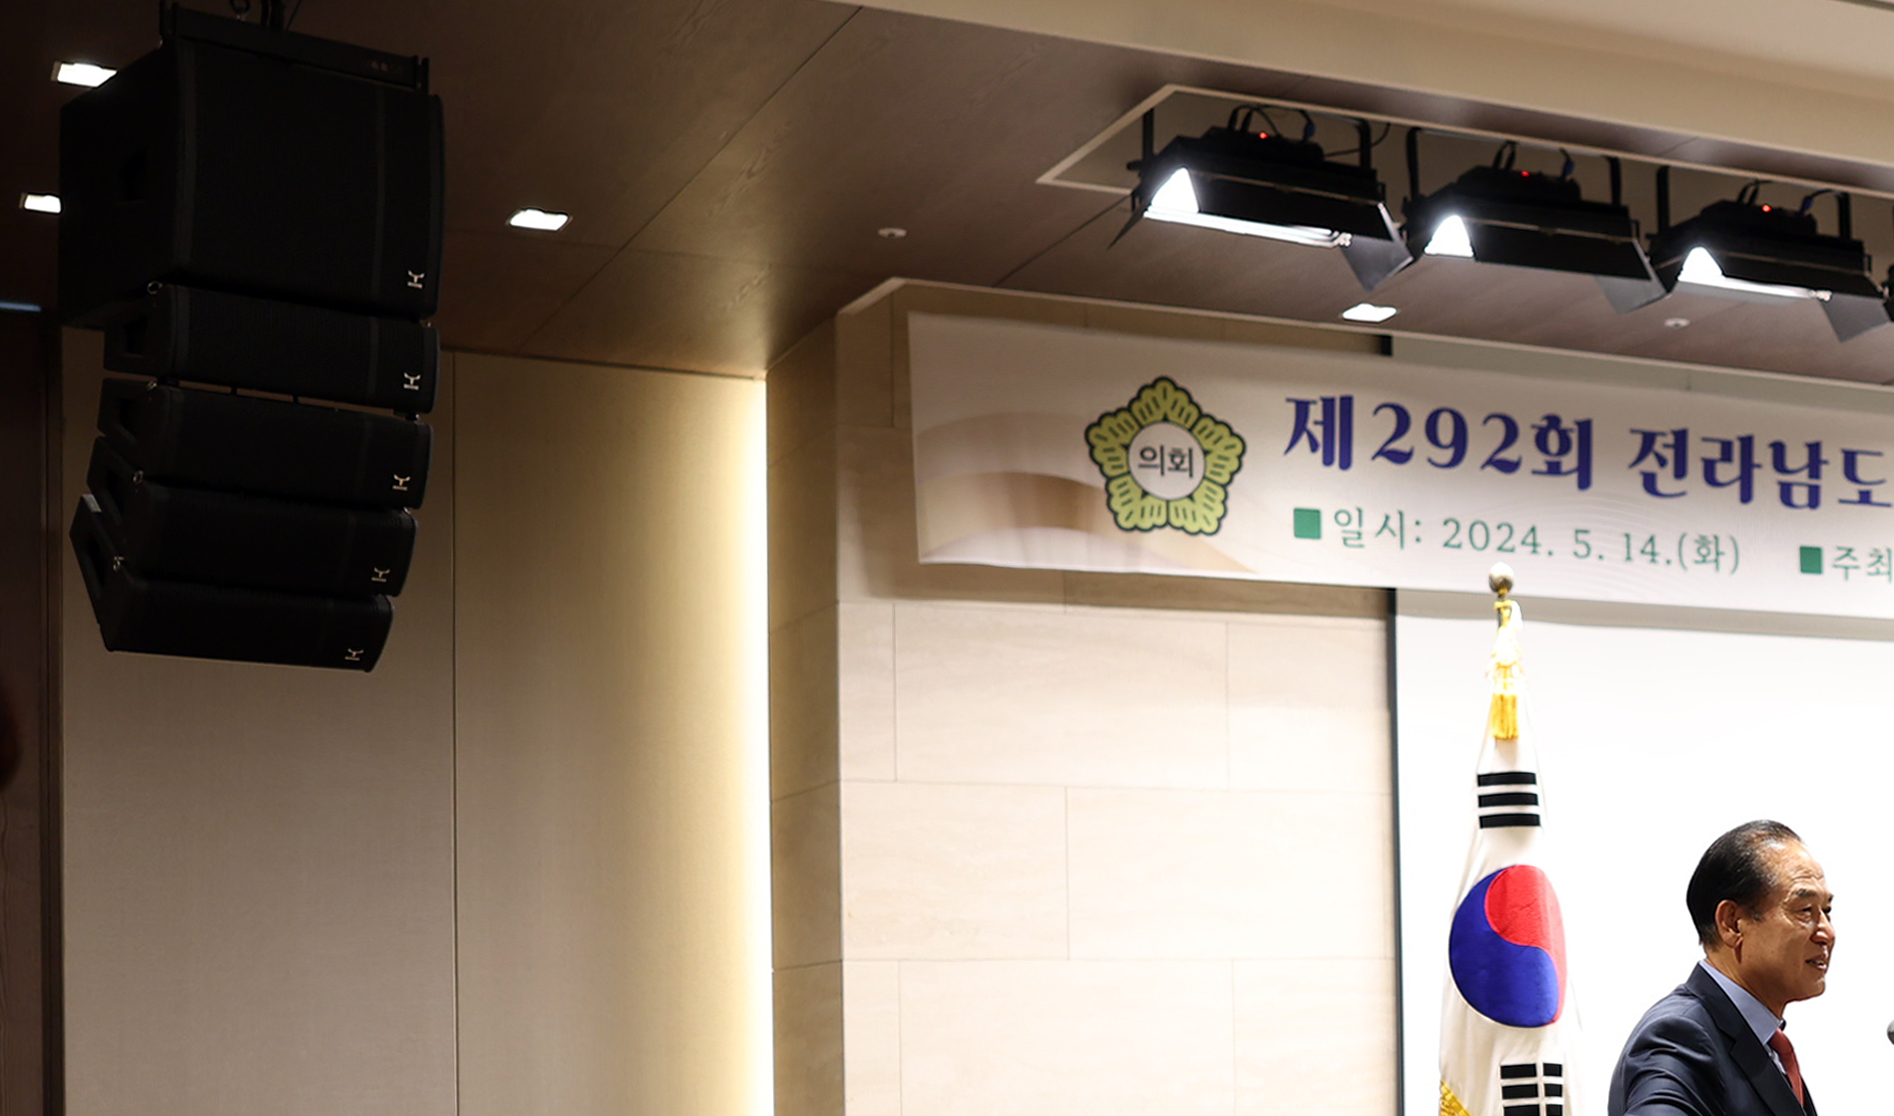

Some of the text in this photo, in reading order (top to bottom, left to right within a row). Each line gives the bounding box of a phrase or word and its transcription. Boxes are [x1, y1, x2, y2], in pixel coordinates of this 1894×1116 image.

[1137, 443, 1195, 480] 의회
[1284, 395, 1593, 491] 제292회
[1629, 428, 1893, 510] 전라남도
[1334, 507, 1739, 576] 일시: 2024. 5. 14.(화)
